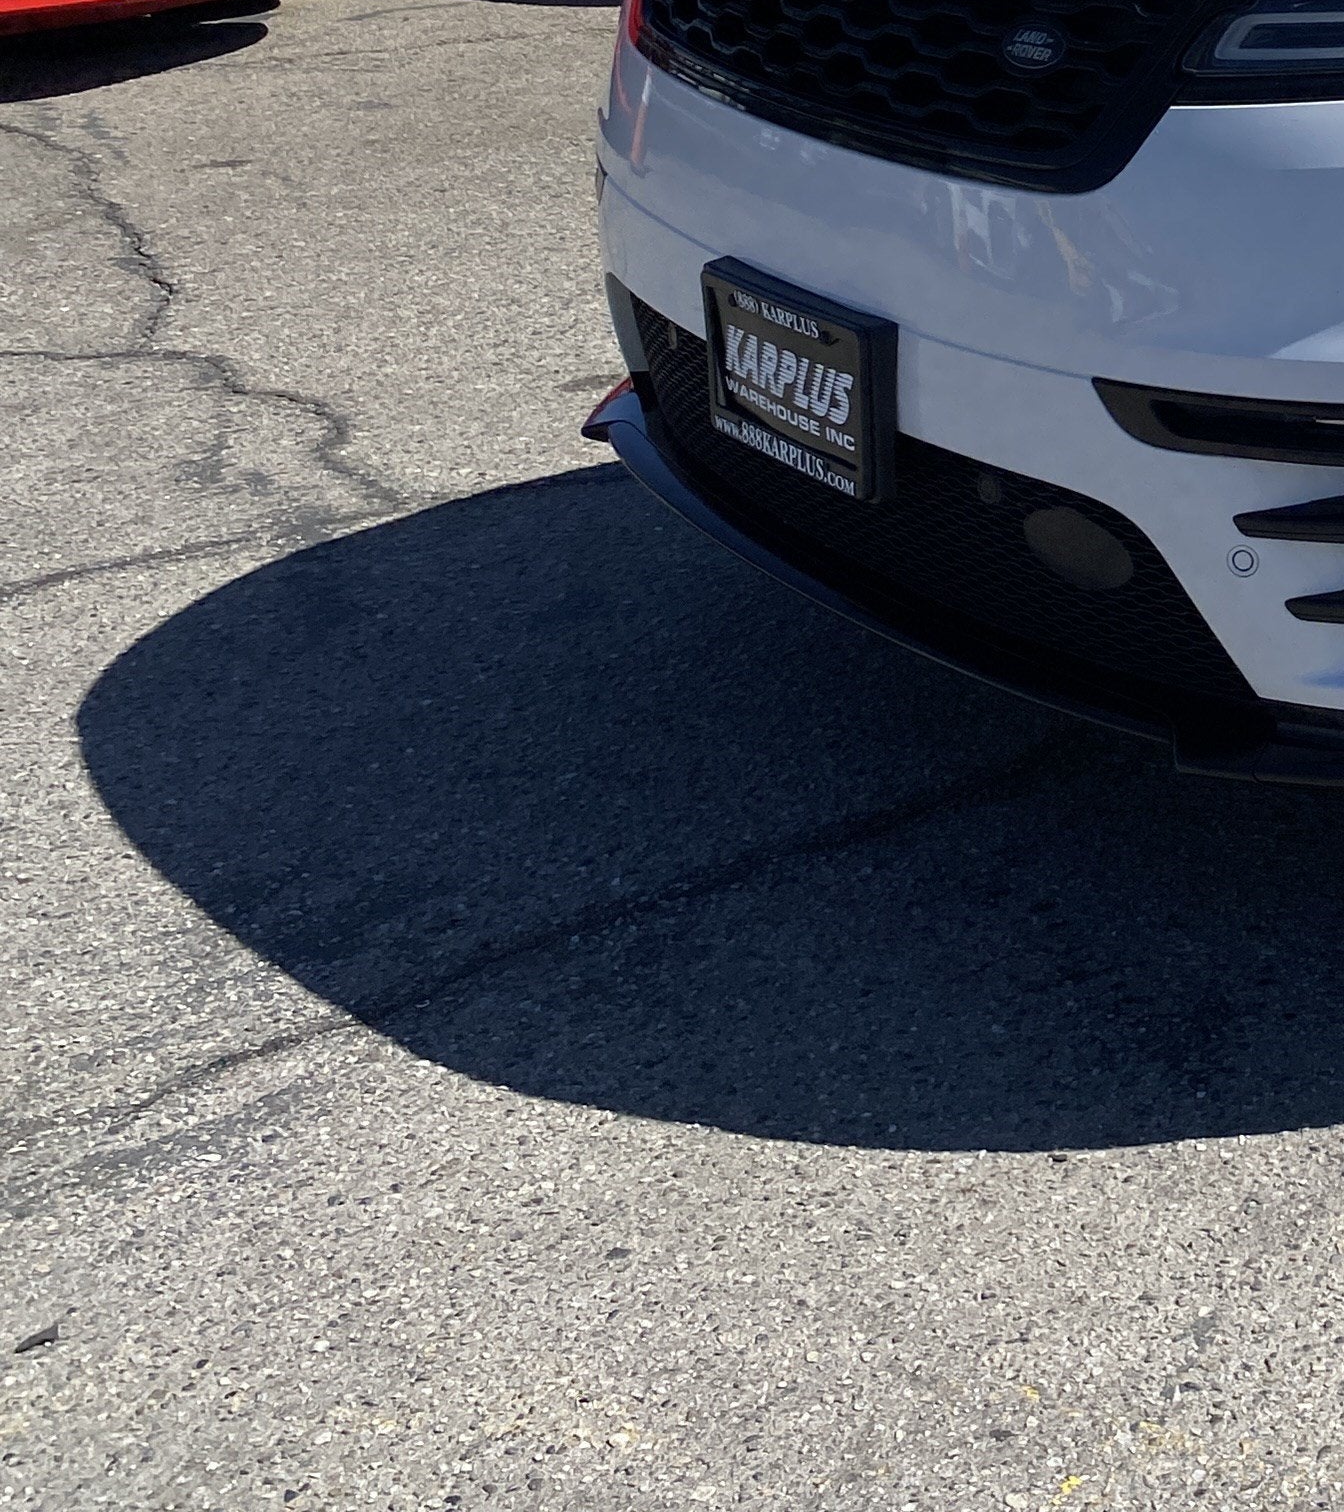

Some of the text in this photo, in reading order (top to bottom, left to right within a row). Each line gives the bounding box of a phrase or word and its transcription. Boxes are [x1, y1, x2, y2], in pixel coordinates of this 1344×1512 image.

[1011, 43, 1053, 61] ROVER
[760, 301, 820, 339] KARPLUS
[725, 324, 854, 426] KARPLUS
[725, 375, 856, 452] WAREHOUSE INC
